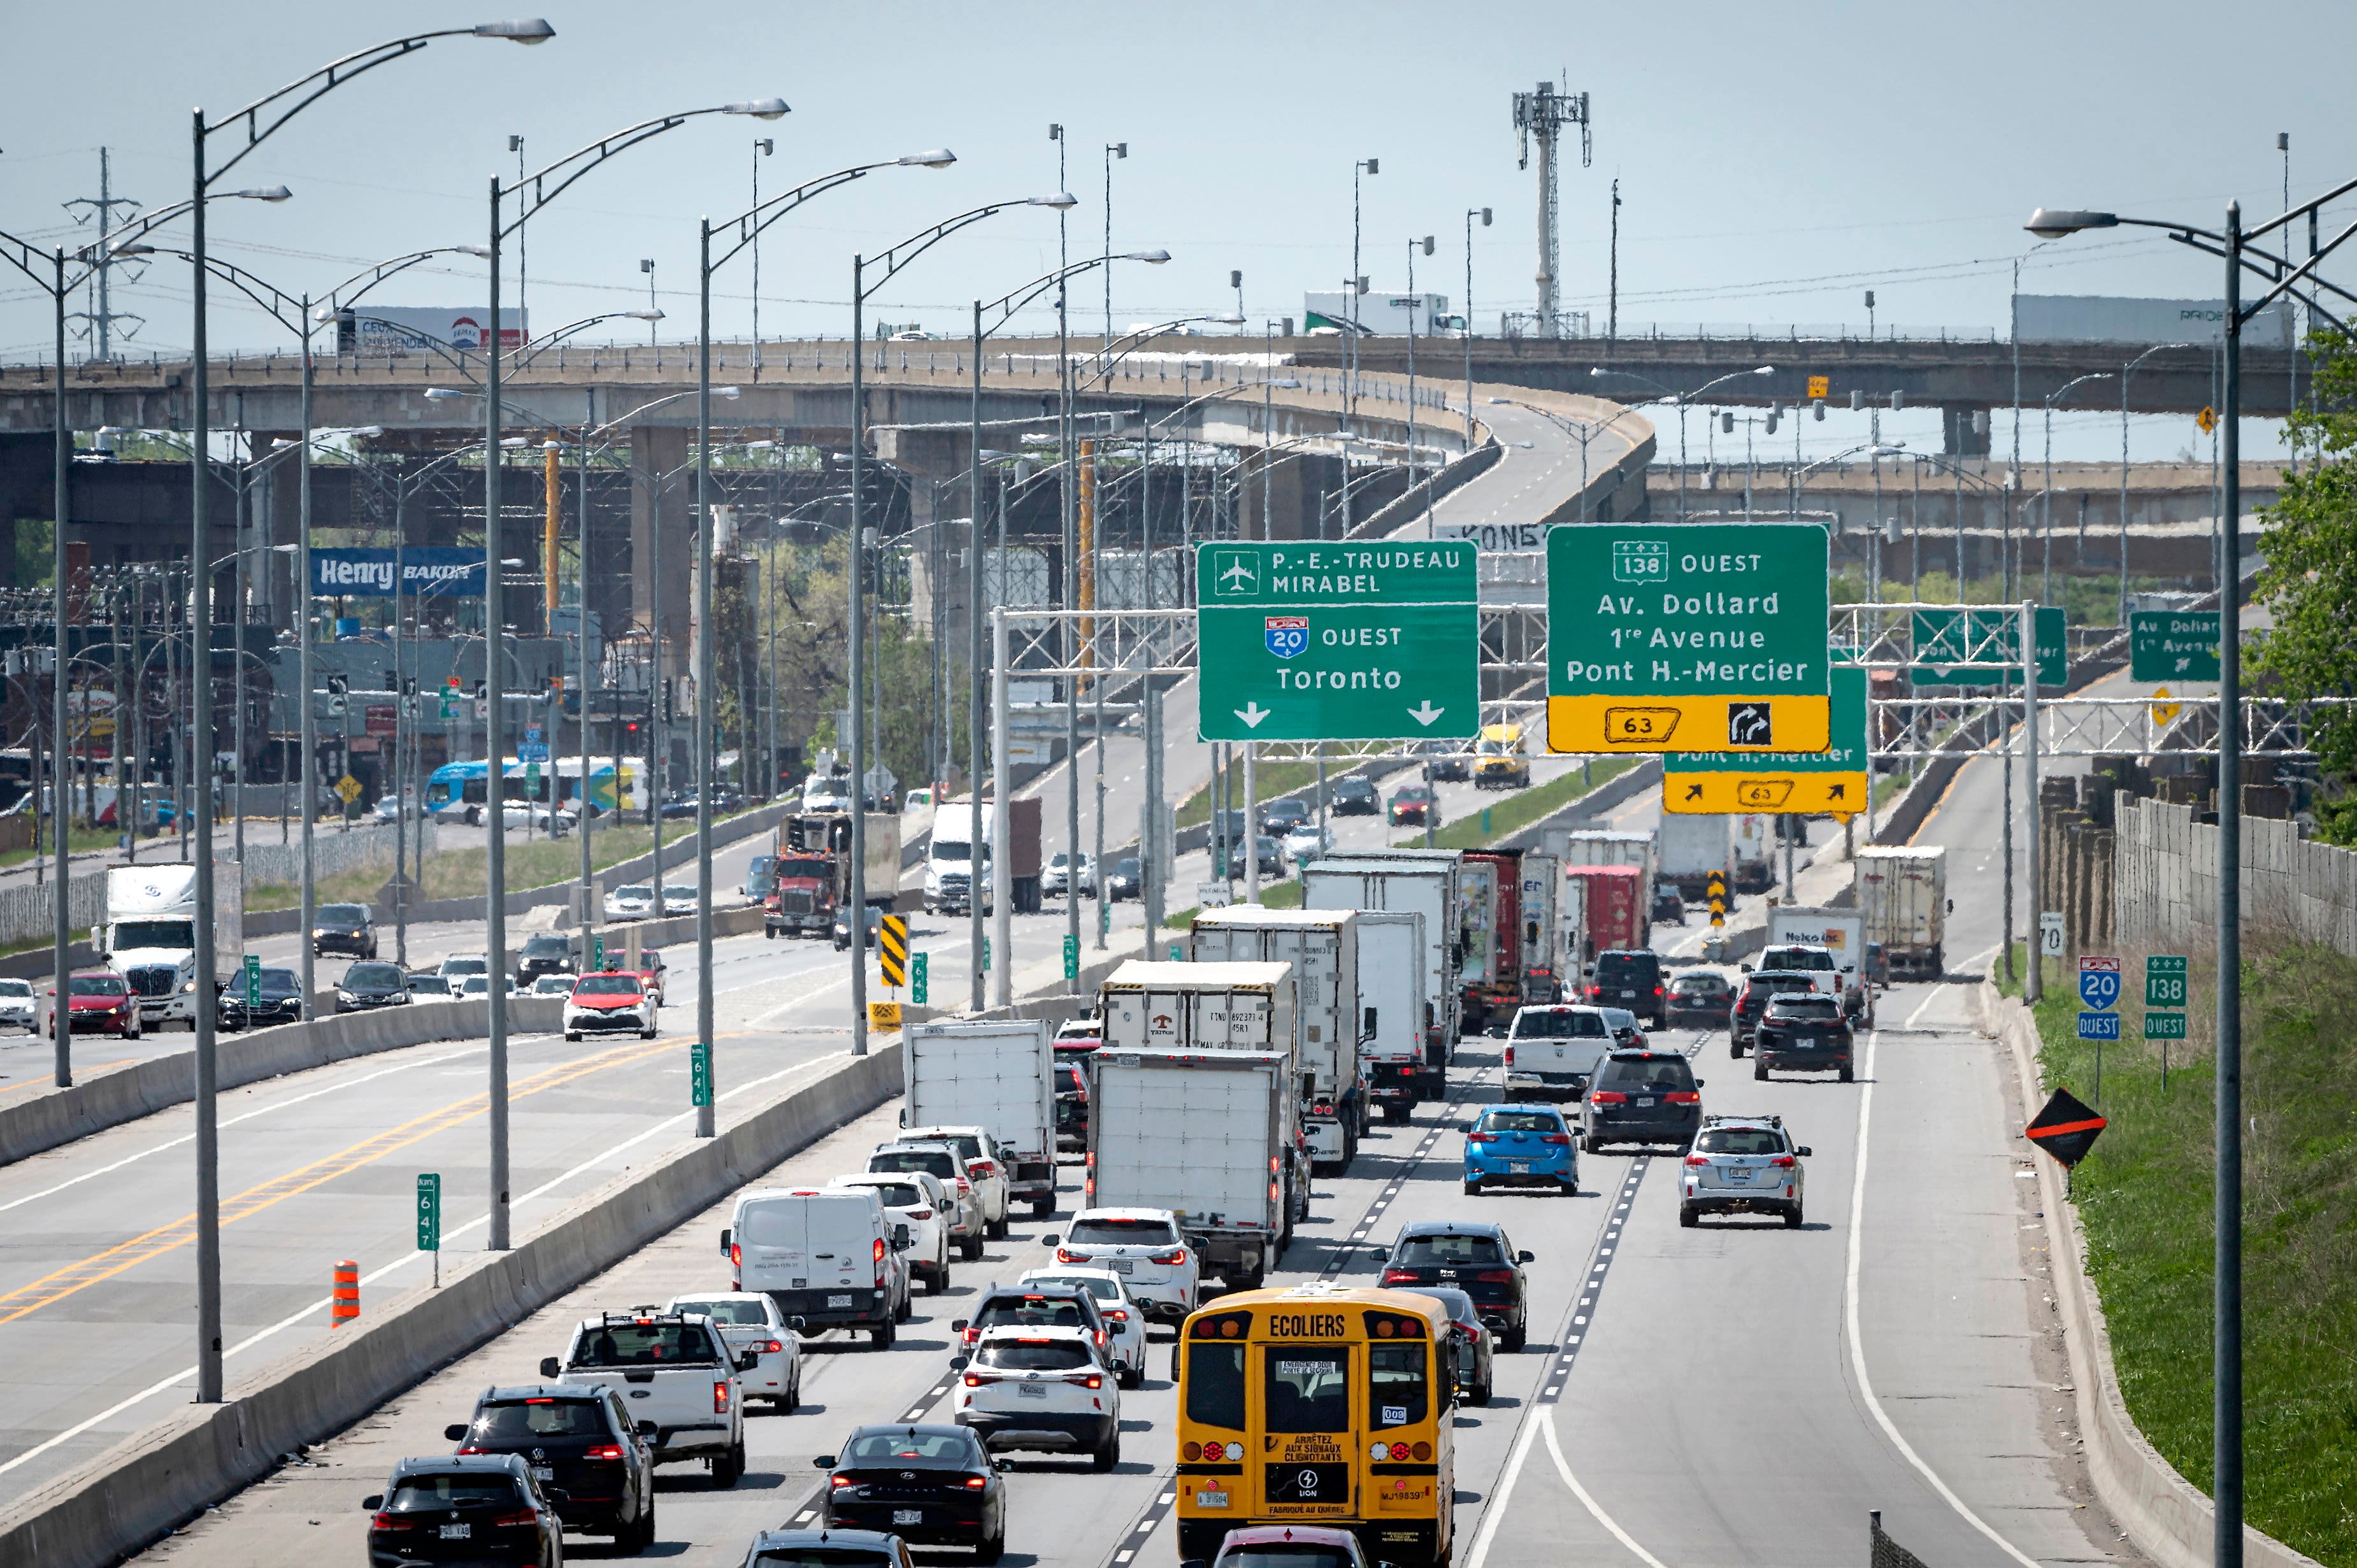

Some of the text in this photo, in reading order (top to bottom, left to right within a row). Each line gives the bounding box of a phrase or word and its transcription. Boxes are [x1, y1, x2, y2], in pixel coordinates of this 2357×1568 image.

[1273, 551, 1460, 569] P.-E.-TRUDEAU
[1624, 554, 1761, 574] 138 OUEST
[320, 559, 394, 590] Henry
[1273, 574, 1380, 593] MIRABEL
[1597, 592, 1779, 615] Av. Dollard
[2170, 619, 2219, 634] Dollar
[1273, 627, 1402, 648] 20 OUEST
[1649, 627, 1765, 648] Avenue
[1277, 667, 1401, 689] Toronto
[1567, 659, 1808, 681] Pont H.-Mercier
[1624, 718, 1652, 733] 63
[1751, 788, 1771, 799] 63
[2085, 975, 2115, 995] 20
[2151, 979, 2182, 999] 138
[2079, 1018, 2117, 1035] OUEST
[2147, 1019, 2183, 1033] OUEST
[1270, 1315, 1345, 1337] ECOLIERS
[1294, 1433, 1332, 1444] ARRÊTEZ
[1305, 1444, 1341, 1452] SIGNAUX
[1285, 1453, 1342, 1462] CLIGNOTANTS
[1270, 1505, 1304, 1514] FABRIQUÉ
